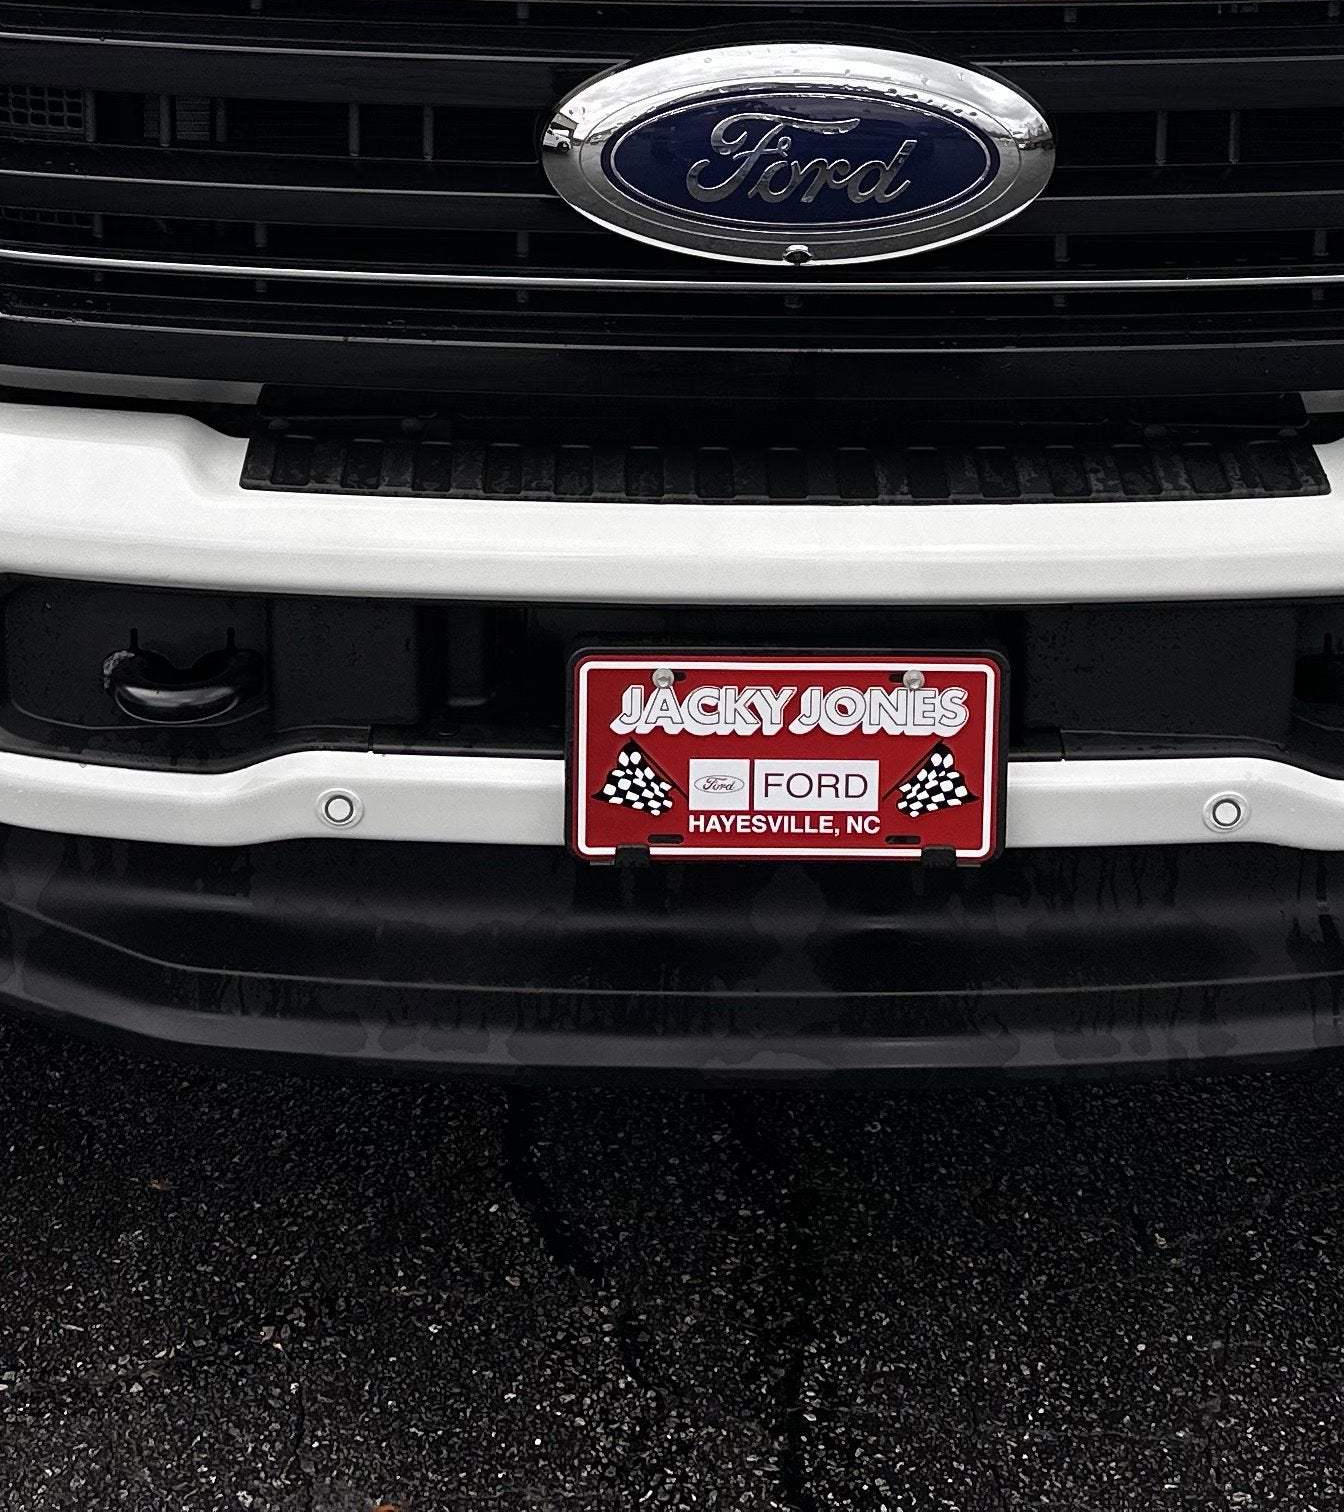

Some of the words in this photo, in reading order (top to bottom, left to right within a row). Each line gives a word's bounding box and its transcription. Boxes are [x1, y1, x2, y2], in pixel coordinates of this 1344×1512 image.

[686, 113, 917, 204] Ford
[610, 684, 797, 736] JACKY
[788, 686, 969, 737] JONES
[702, 777, 736, 791] Ford
[764, 772, 868, 799] FORD
[688, 815, 840, 836] HAYESVILLE,
[846, 815, 881, 834] NC
